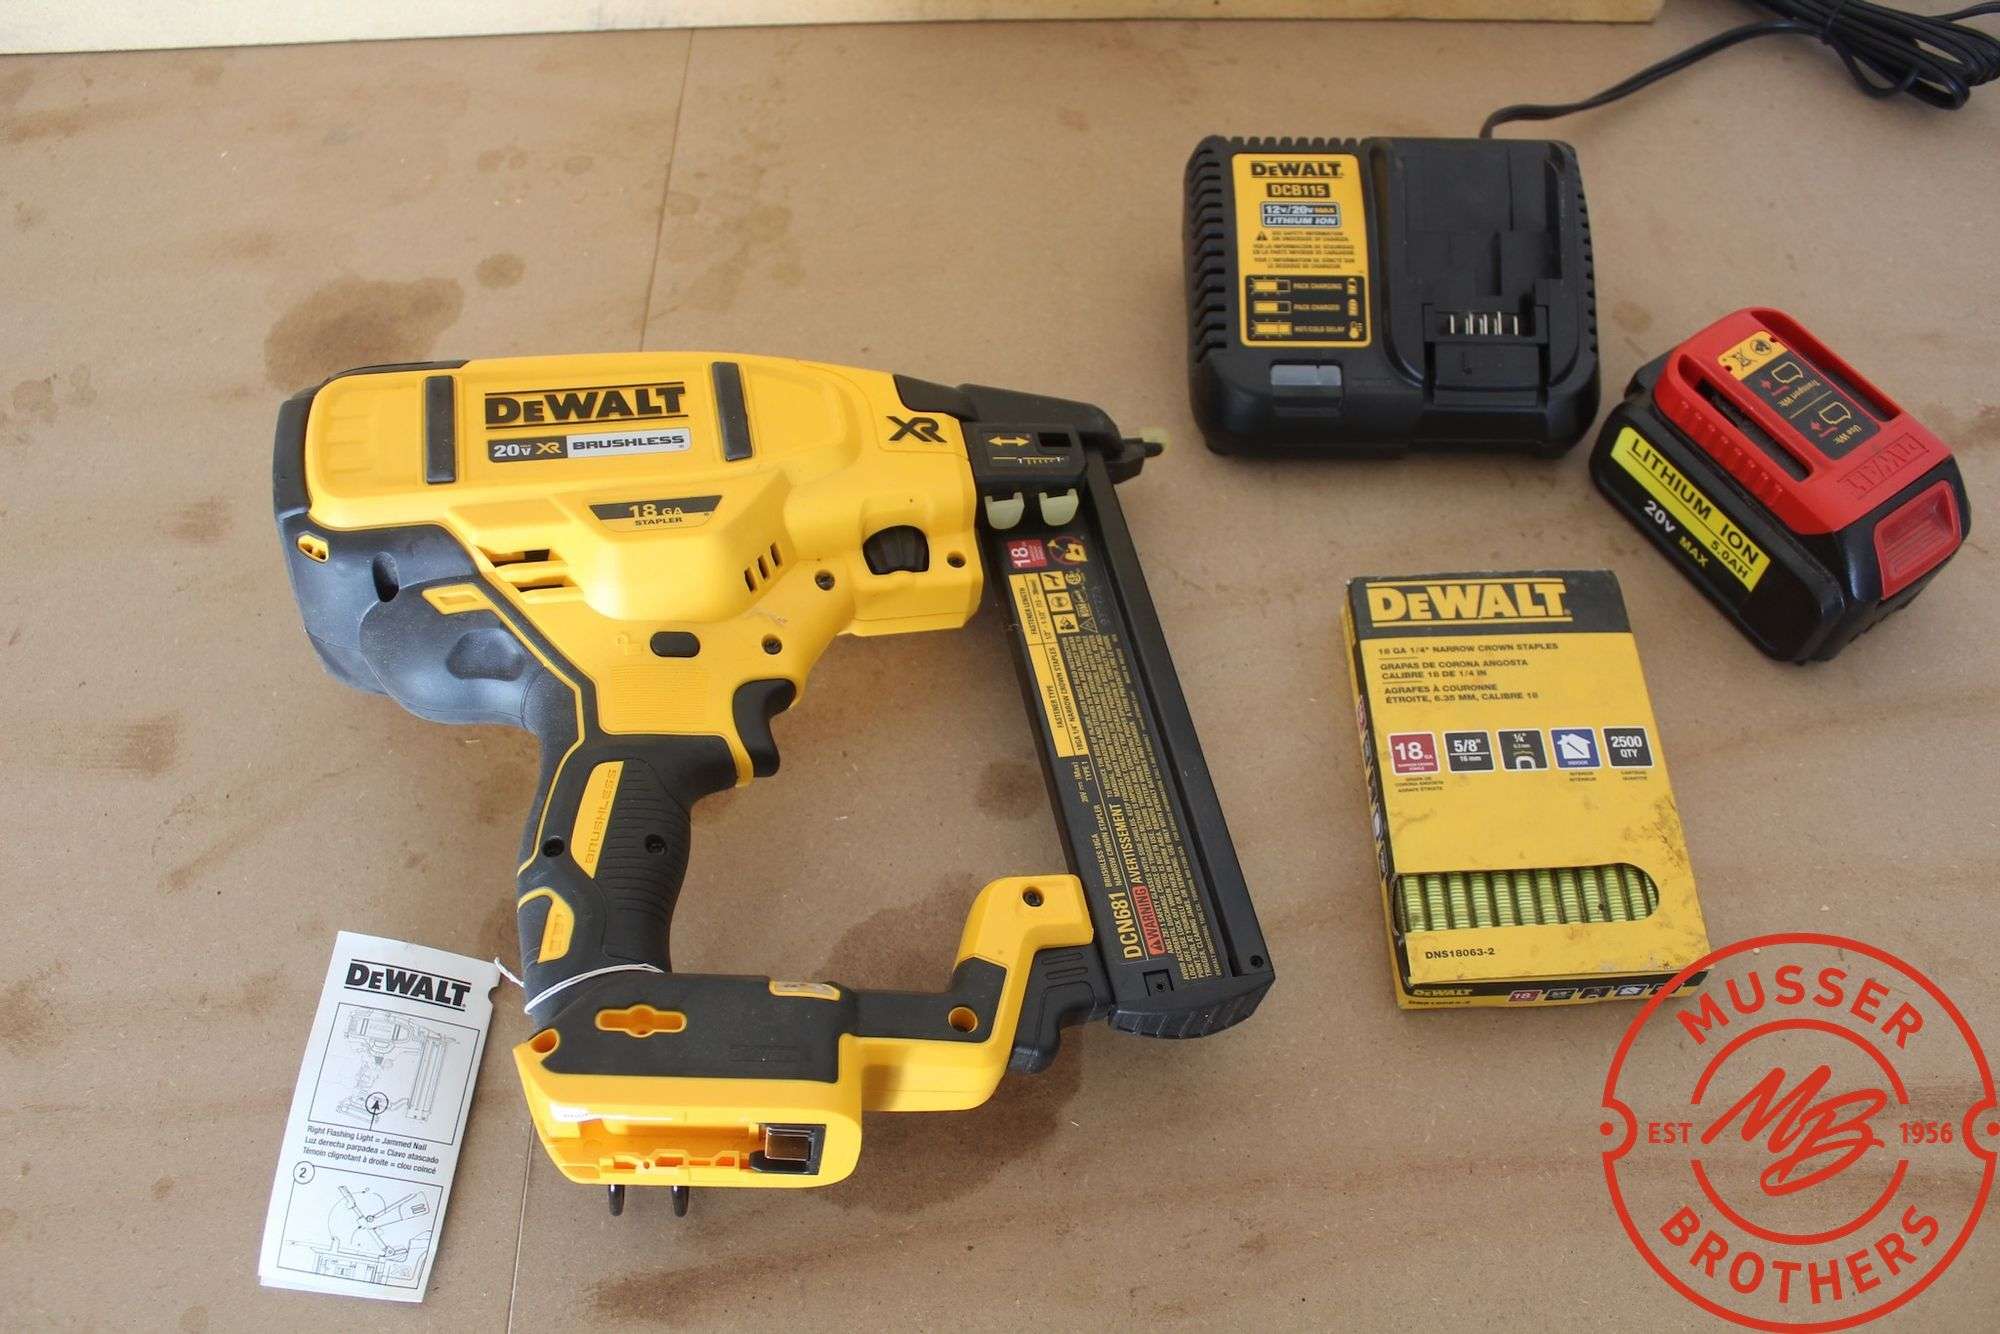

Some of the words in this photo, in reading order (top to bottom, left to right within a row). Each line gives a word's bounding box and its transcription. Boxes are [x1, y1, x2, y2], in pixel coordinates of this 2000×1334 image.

[1251, 161, 1342, 177] DeWALT
[1271, 184, 1327, 196] DCB115
[1266, 216, 1312, 225] LITHIUM
[1315, 216, 1336, 225] ION
[485, 386, 686, 425] DeWALT
[886, 415, 947, 443] XR
[536, 442, 562, 455] XR
[572, 435, 684, 450] BRUSHLESS
[1631, 438, 1712, 520] LITHIUM
[1719, 523, 1760, 566] ION
[635, 516, 683, 526] STAPLER
[1643, 500, 1677, 533] 20v
[1679, 536, 1710, 568] MAX
[1011, 547, 1031, 567] 18
[1710, 540, 1749, 580] 5.0AH
[1366, 583, 1567, 621] DeWALT
[1049, 647, 1061, 670] STAPLES
[1393, 647, 1407, 655] GA
[1432, 645, 1475, 653] NARROW
[1478, 644, 1514, 652] CROWN
[1516, 642, 1559, 650] STAPLES
[1380, 662, 1420, 670] GRAPAS
[1423, 661, 1437, 669] DE
[1439, 660, 1480, 668] CORONA
[1483, 658, 1528, 667] ANGOSTA
[1382, 671, 1423, 679] CALIBRE
[1443, 670, 1456, 678] DE
[1459, 670, 1475, 678] 1/4
[1476, 669, 1487, 677] IN
[1384, 686, 1430, 695] AGRAFES
[1443, 683, 1497, 692] COURONNE
[1482, 692, 1524, 700] CALIBRE
[1527, 691, 1539, 700] 18
[1051, 700, 1064, 727] FASTENER
[1063, 696, 1076, 721] NARROW
[1394, 741, 1424, 760] 18
[1453, 739, 1481, 752] 5/8"
[1610, 736, 1643, 747] 2500
[1620, 749, 1638, 758] QTY
[584, 769, 617, 864] BRUSHLESS
[1094, 804, 1107, 830] STAPLER
[1101, 832, 1114, 855] CROWN
[1110, 802, 1143, 884] AVERTISSEMENT
[1096, 850, 1113, 887] BRUSHLESS
[1108, 856, 1123, 885] NARROW
[1108, 891, 1142, 957] DCN681
[1134, 886, 1159, 938] WARNING
[1425, 947, 1495, 959] DNS18063-2
[345, 962, 471, 1008] DeWALT
[307, 1125, 325, 1135] Right
[326, 1129, 355, 1140] Flashing
[356, 1132, 374, 1142] Light
[382, 1138, 411, 1148] Jammed
[413, 1142, 427, 1150] Nail
[303, 1146, 326, 1156] Témoin
[328, 1150, 361, 1162] clignotant
[368, 1157, 388, 1167] droite
[397, 1161, 411, 1171] clou
[413, 1164, 437, 1174] coincé
[305, 1136, 316, 1144] Luz
[318, 1139, 345, 1149] derecha
[346, 1143, 378, 1154] parpadea
[387, 1148, 406, 1158] Clavo
[407, 1153, 439, 1164] atascado
[298, 1167, 308, 1178] 2
